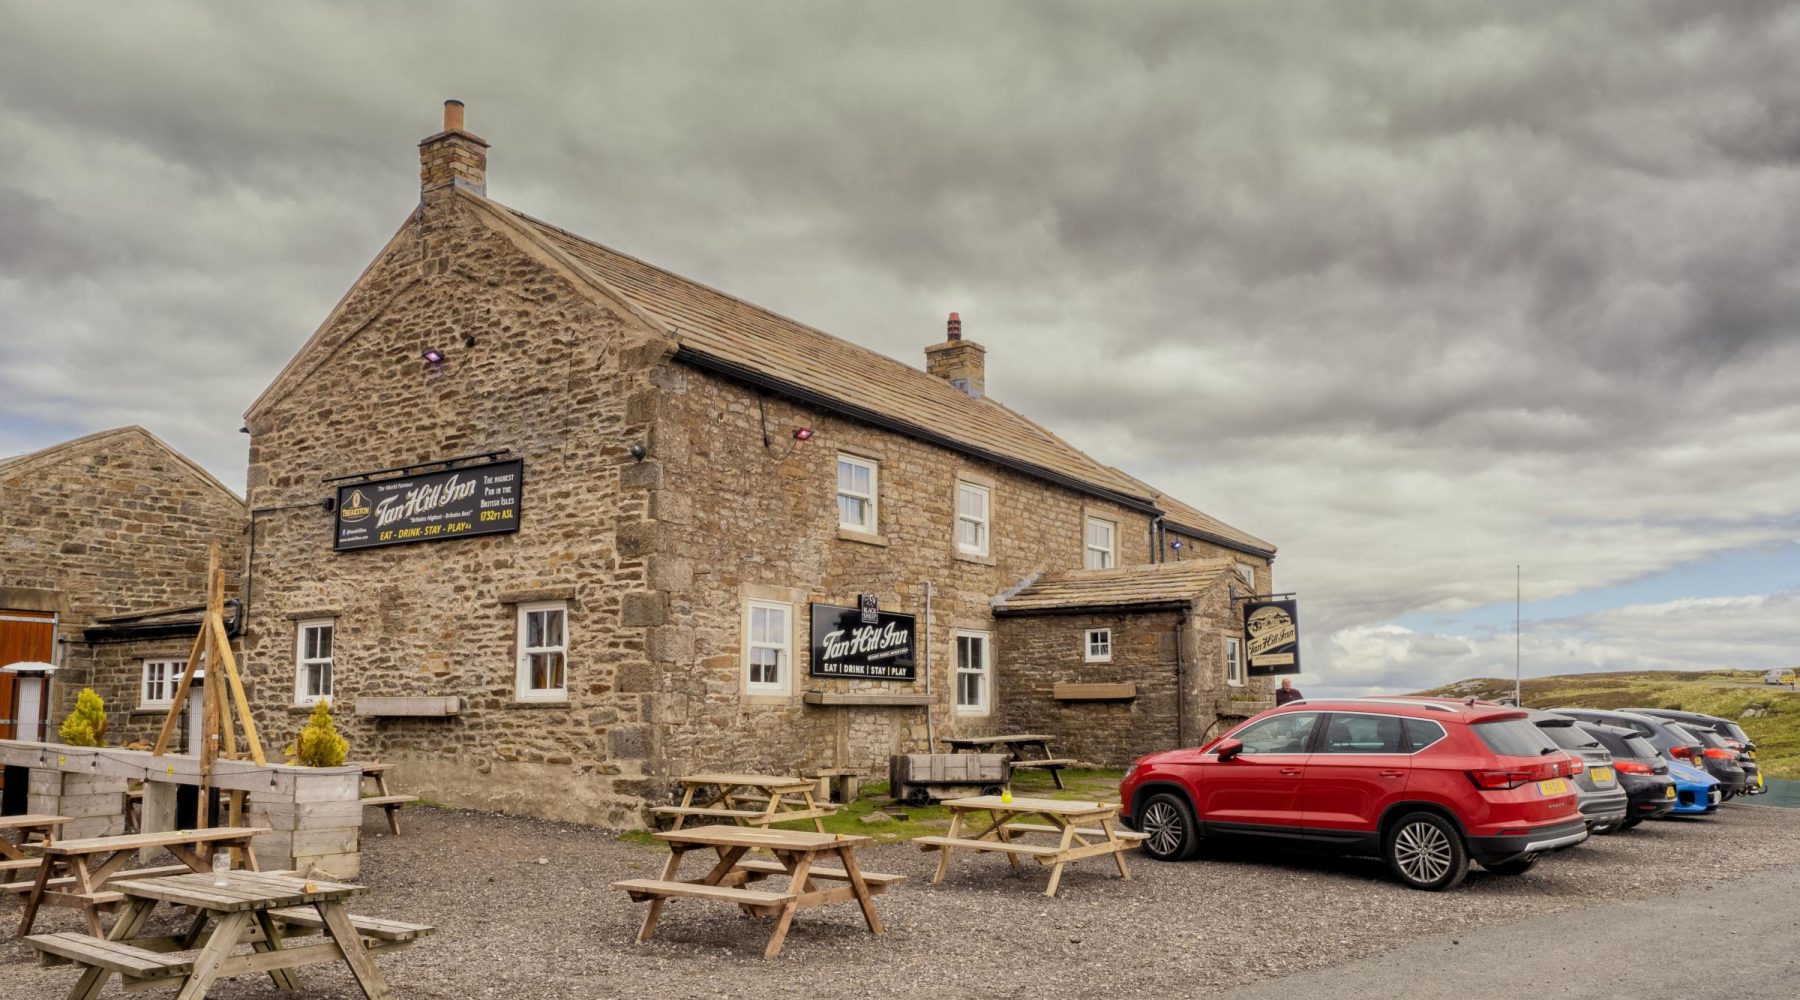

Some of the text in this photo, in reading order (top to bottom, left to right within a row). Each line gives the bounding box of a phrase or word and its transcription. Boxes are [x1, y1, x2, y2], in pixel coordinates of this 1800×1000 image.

[375, 473, 476, 528] Tan Hill Inn
[342, 506, 369, 517] THEAKSTON
[502, 509, 513, 519] ASL
[380, 531, 393, 540] EAT
[424, 525, 442, 536] STAY
[447, 521, 466, 532] PLAY
[822, 629, 850, 661] Tan
[850, 625, 882, 655] Hill
[880, 621, 908, 649] Inn
[1249, 629, 1294, 654] Tan Hill Inn
[824, 663, 907, 676] EAT DRINK STAY PLAY
